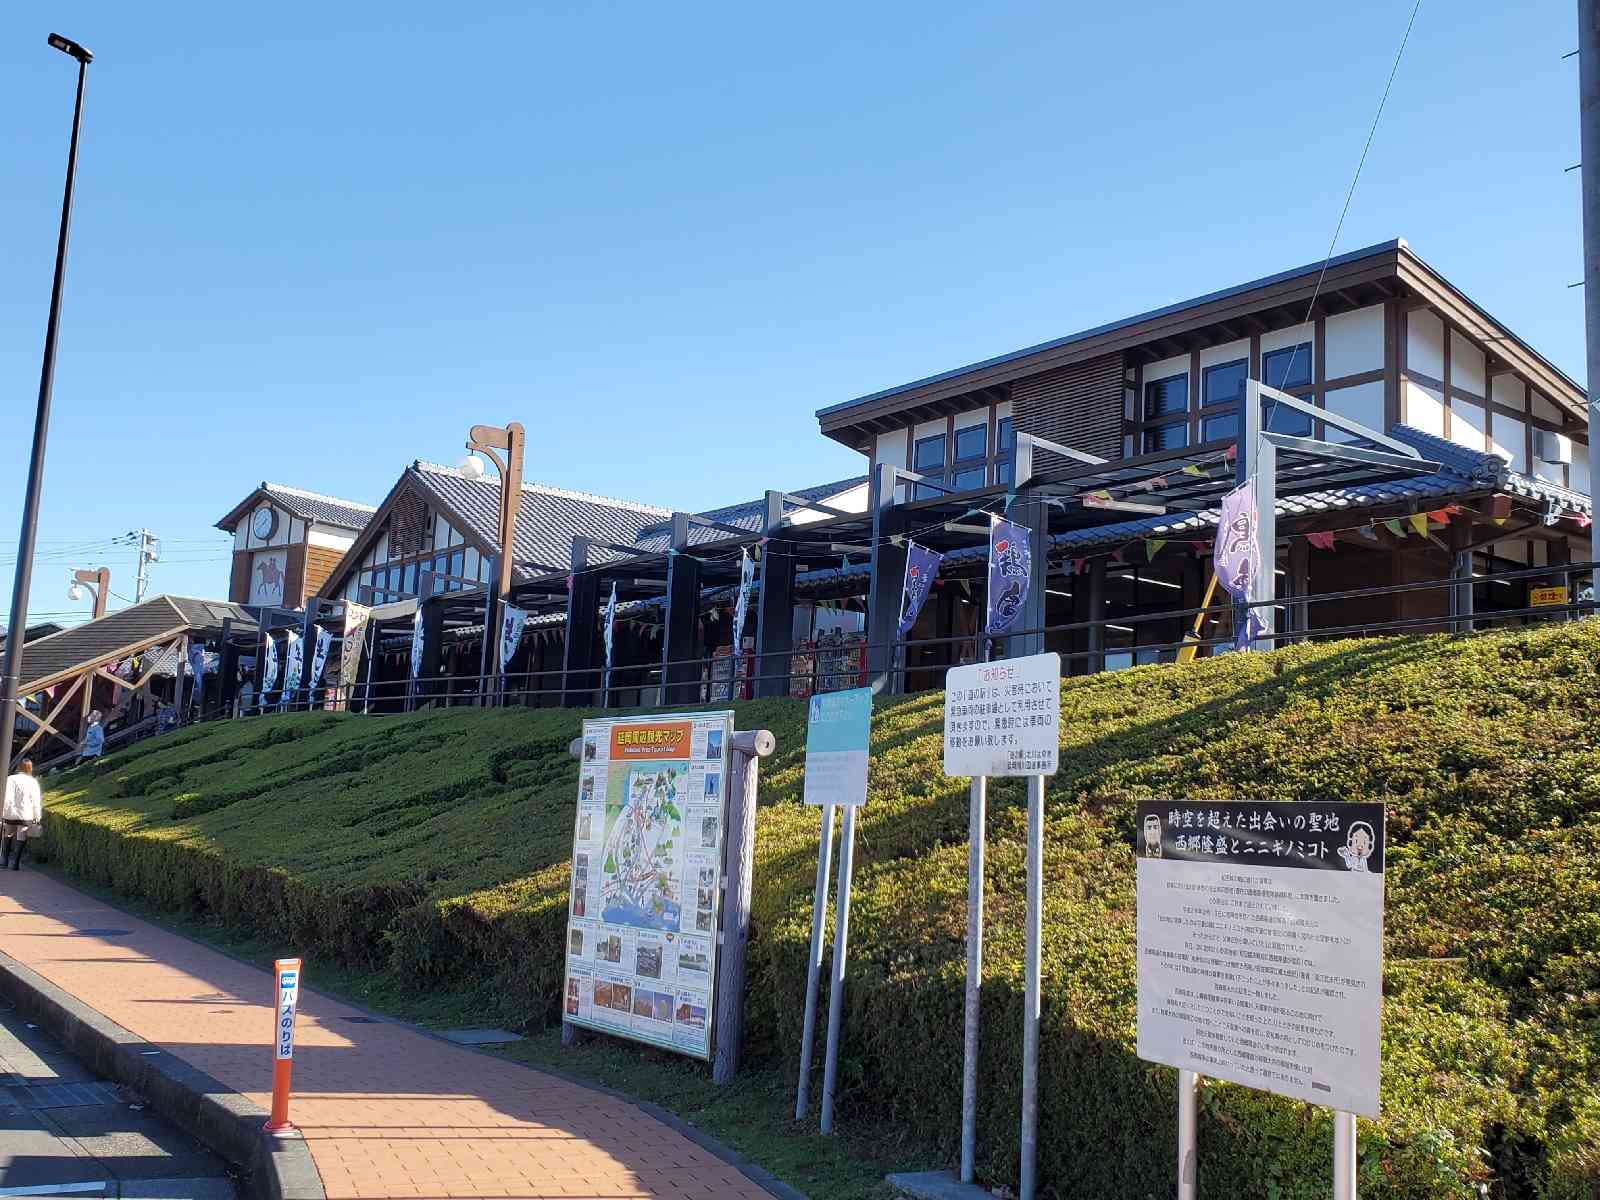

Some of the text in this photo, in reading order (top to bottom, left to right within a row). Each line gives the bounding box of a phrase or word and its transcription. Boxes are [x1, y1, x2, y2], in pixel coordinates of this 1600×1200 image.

[1168, 808, 1340, 833] 時空を超えた出会いの聖地
[1175, 835, 1329, 860] 西郷隆盛とニニギノミコト
